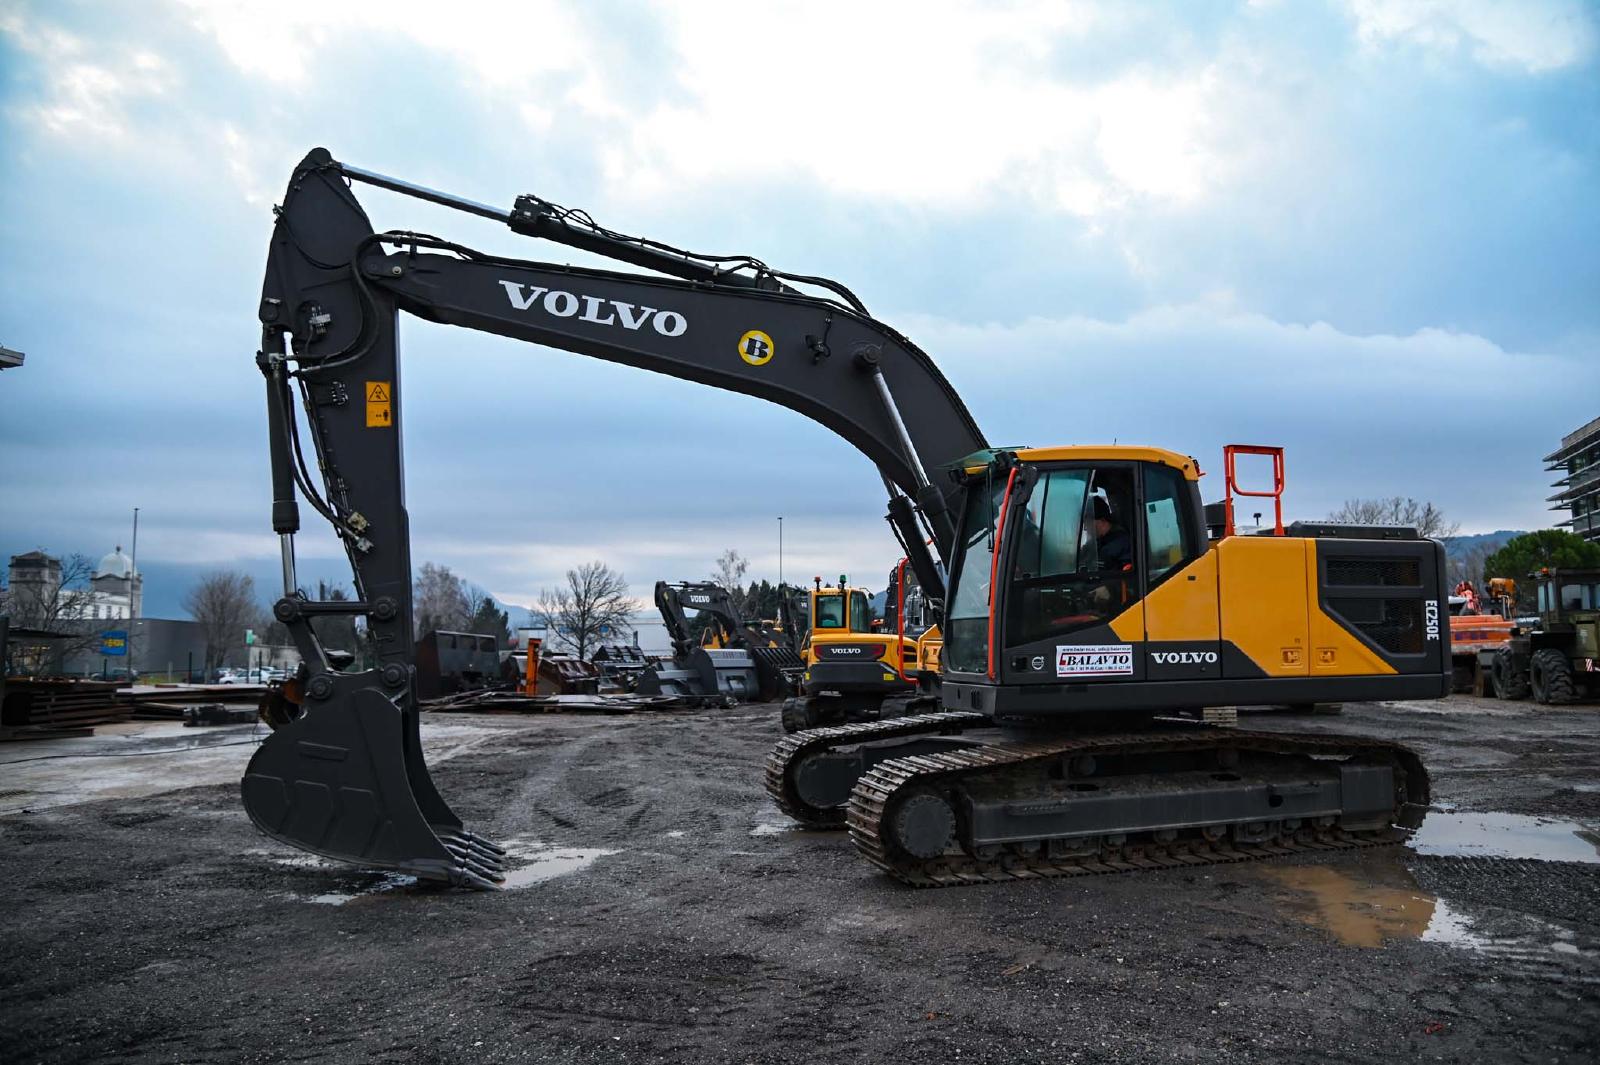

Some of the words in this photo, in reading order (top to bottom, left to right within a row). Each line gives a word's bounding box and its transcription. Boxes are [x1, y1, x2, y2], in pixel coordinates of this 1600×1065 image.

[498, 280, 688, 337] VOLVO
[745, 337, 769, 360] B
[690, 595, 710, 603] VOLVO
[1425, 600, 1439, 641] EC250E
[830, 647, 861, 655] VOLVO
[1067, 655, 1129, 666] BALAVTO
[1151, 652, 1218, 664] VOLVO
